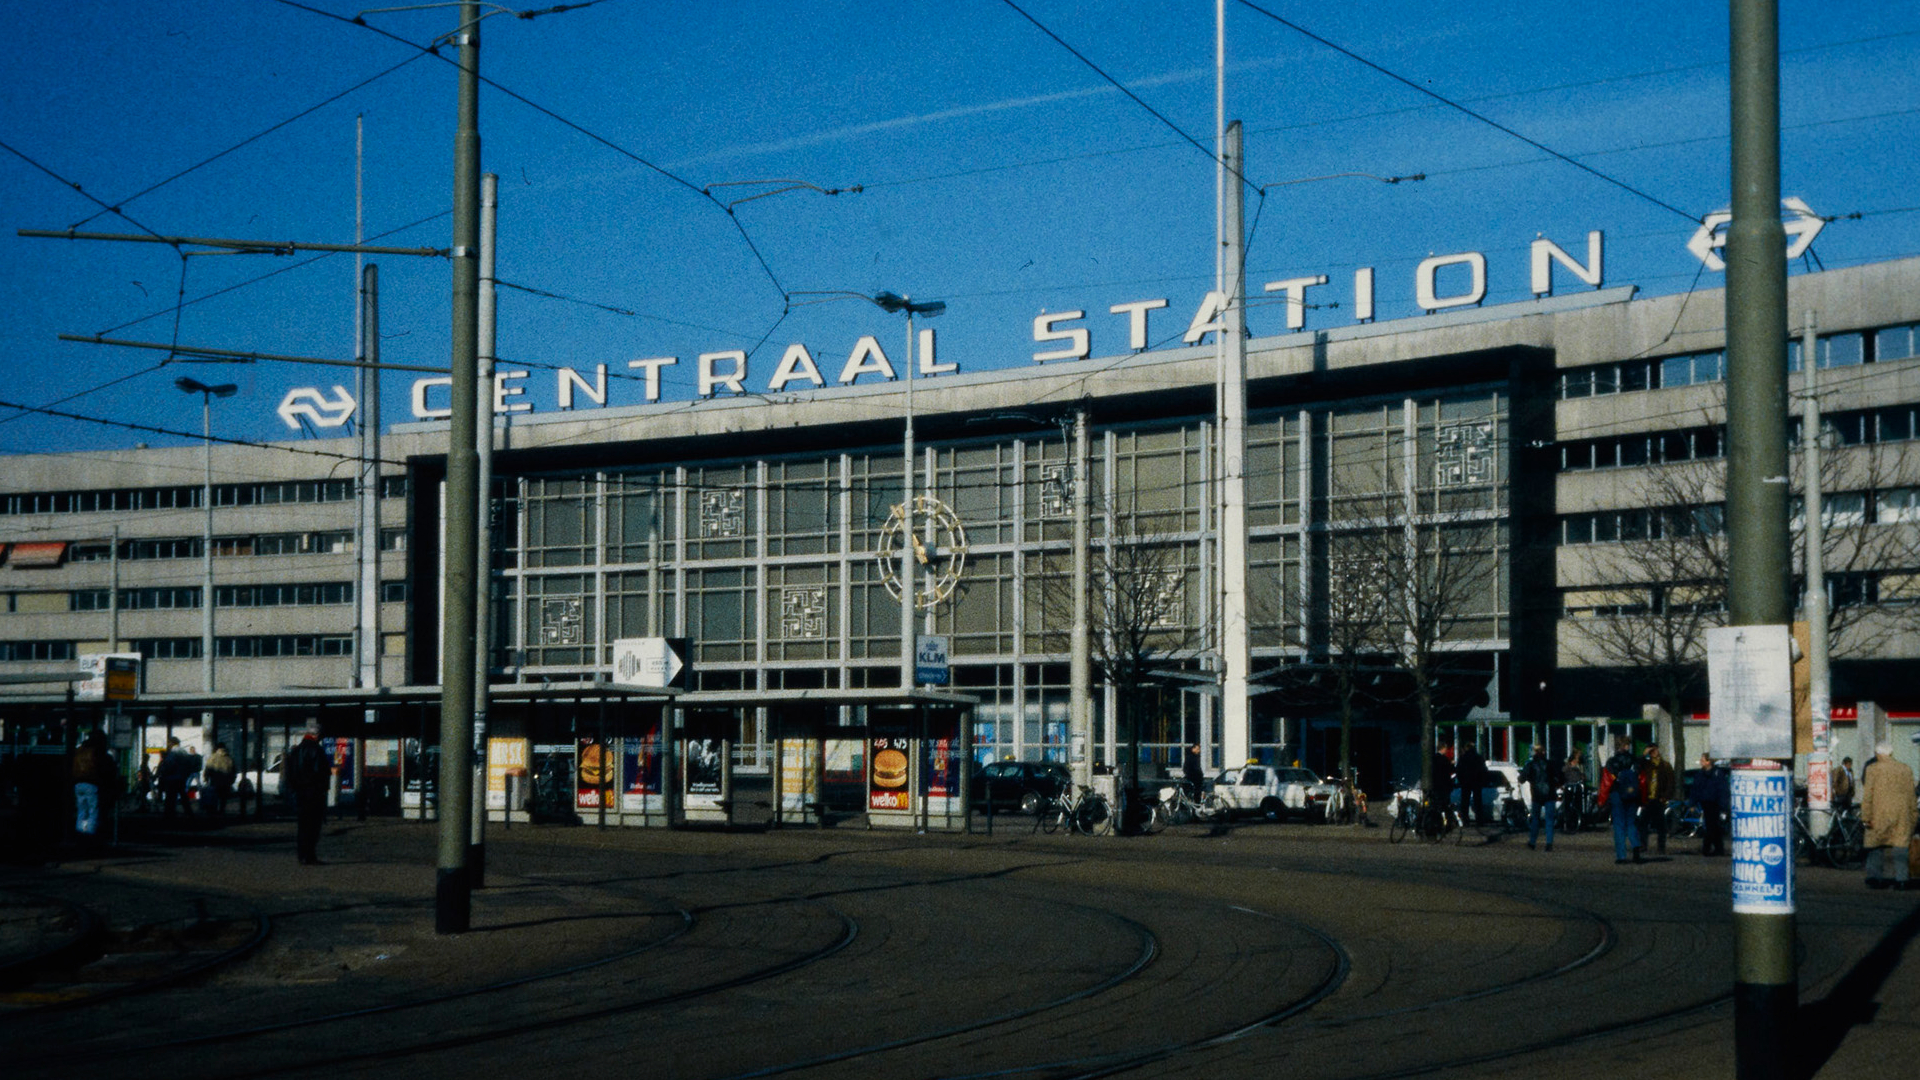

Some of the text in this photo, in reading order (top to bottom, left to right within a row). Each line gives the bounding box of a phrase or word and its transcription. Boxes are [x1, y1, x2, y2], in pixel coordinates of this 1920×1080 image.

[411, 230, 1605, 420] CENTRAAL STATION
[919, 652, 946, 663] KLM
[1750, 797, 1785, 812] MRT
